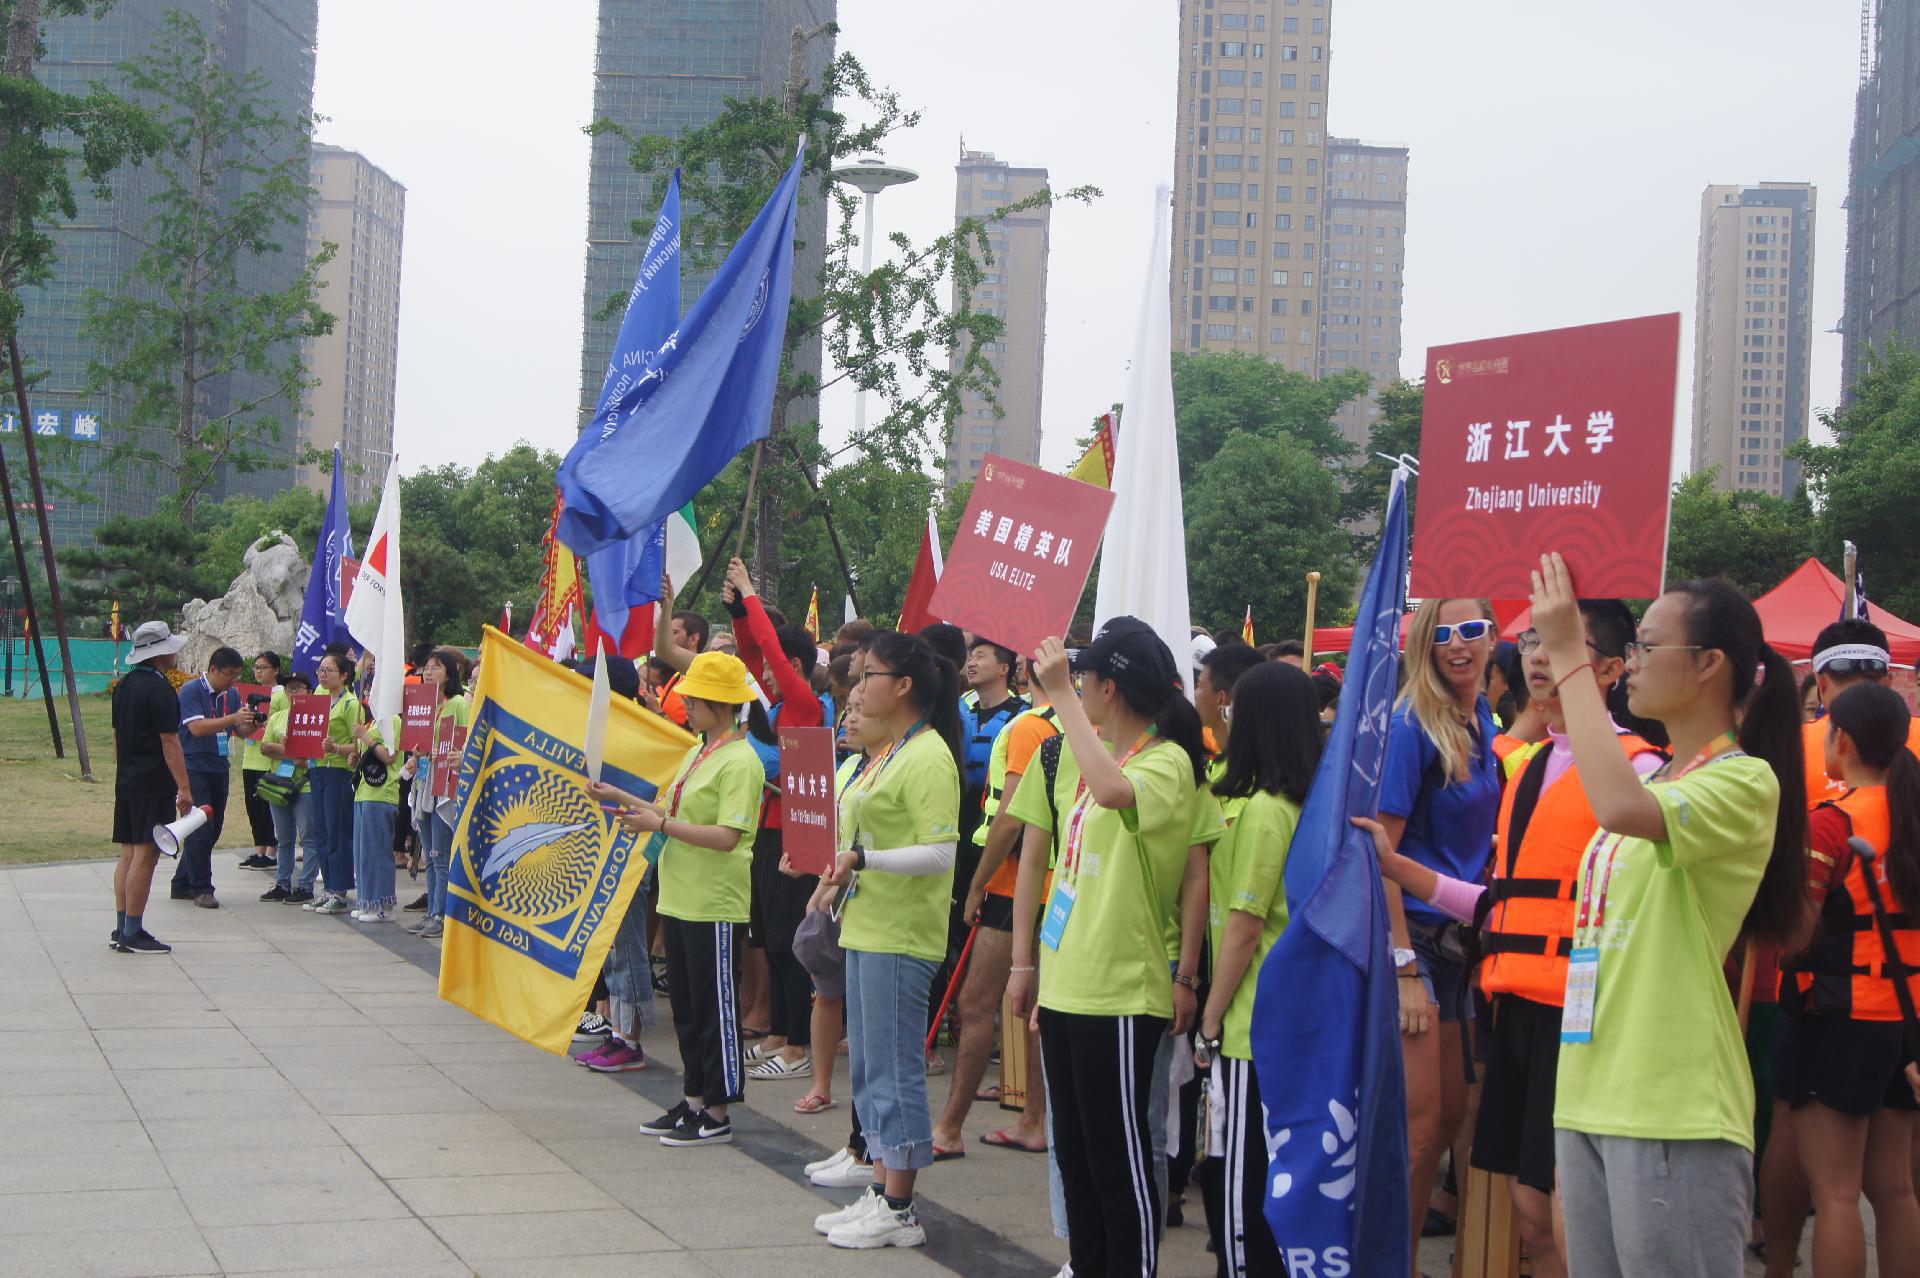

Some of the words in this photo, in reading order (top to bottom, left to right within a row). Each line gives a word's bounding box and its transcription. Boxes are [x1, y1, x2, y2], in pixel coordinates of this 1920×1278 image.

[1465, 410, 1615, 463] 浙江大学
[1465, 485, 1523, 514] Zhejiang
[1528, 480, 1602, 508] University
[973, 509, 1073, 568] 美国精英队
[989, 560, 1009, 581] USA
[1008, 563, 1037, 592] ELITE
[787, 771, 828, 798] 中山大学
[1279, 1245, 1351, 1278] RS
